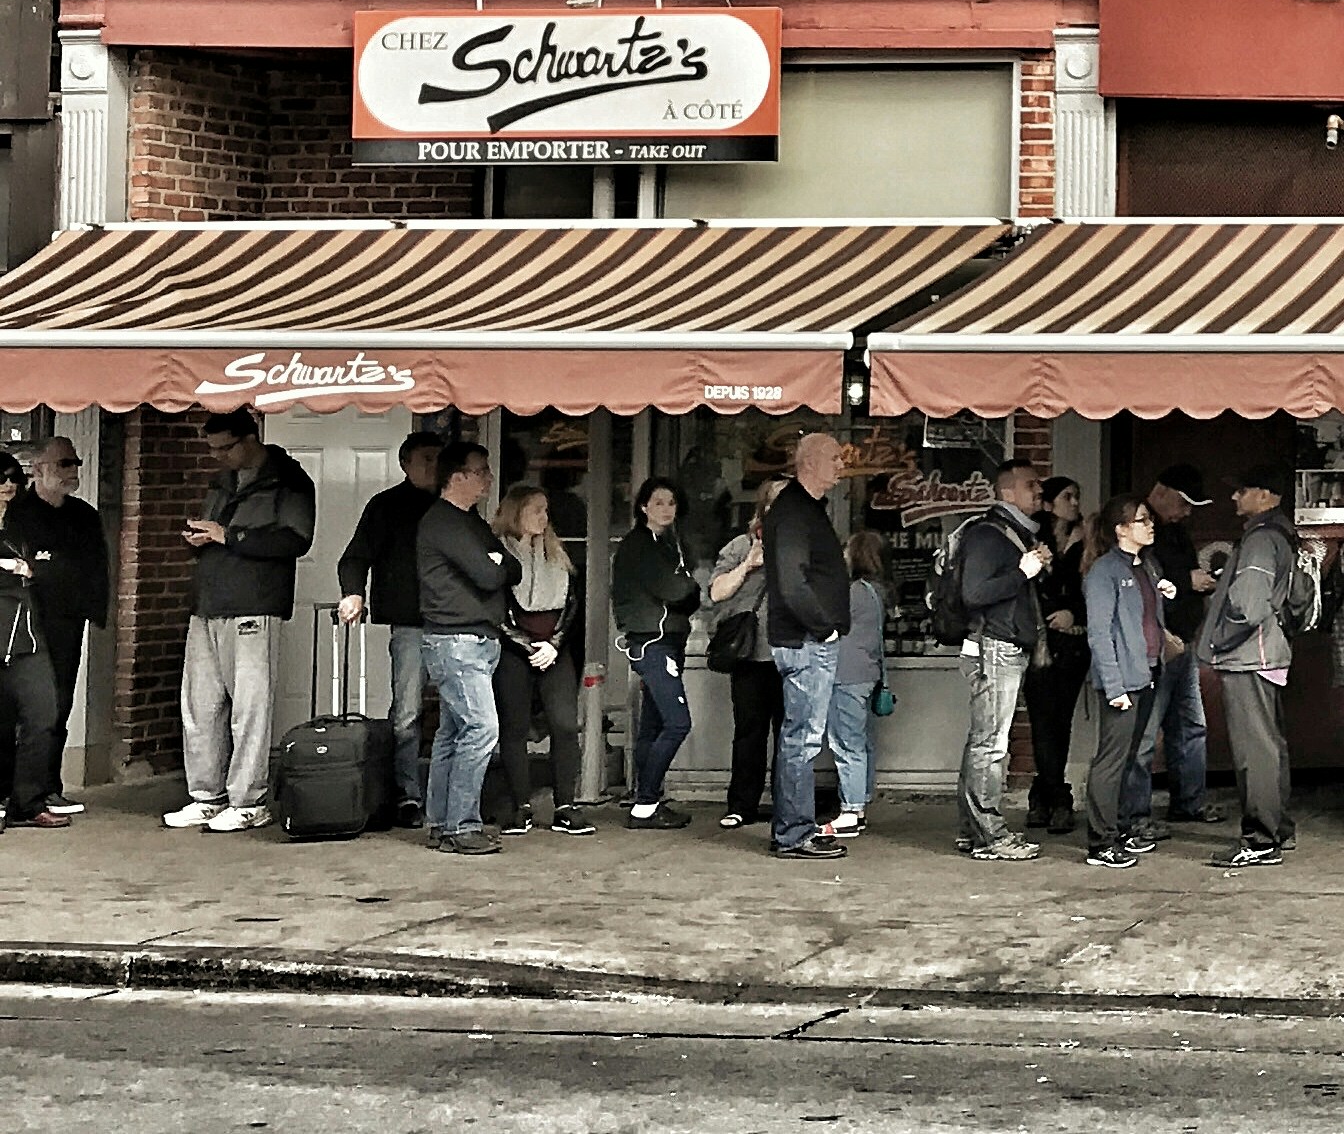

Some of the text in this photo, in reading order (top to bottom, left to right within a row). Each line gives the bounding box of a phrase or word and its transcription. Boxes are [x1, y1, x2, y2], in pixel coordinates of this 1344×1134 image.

[381, 32, 448, 51] CHEZ
[418, 16, 708, 134] Schwartz's
[663, 99, 743, 121] À CÔTÉ
[418, 141, 481, 161] POUR
[487, 141, 610, 161] EMPORTER
[629, 145, 669, 159] TAKE
[672, 145, 706, 159] OUT
[194, 352, 416, 407] Schwartz's
[704, 385, 782, 400] DEPUIS 1928
